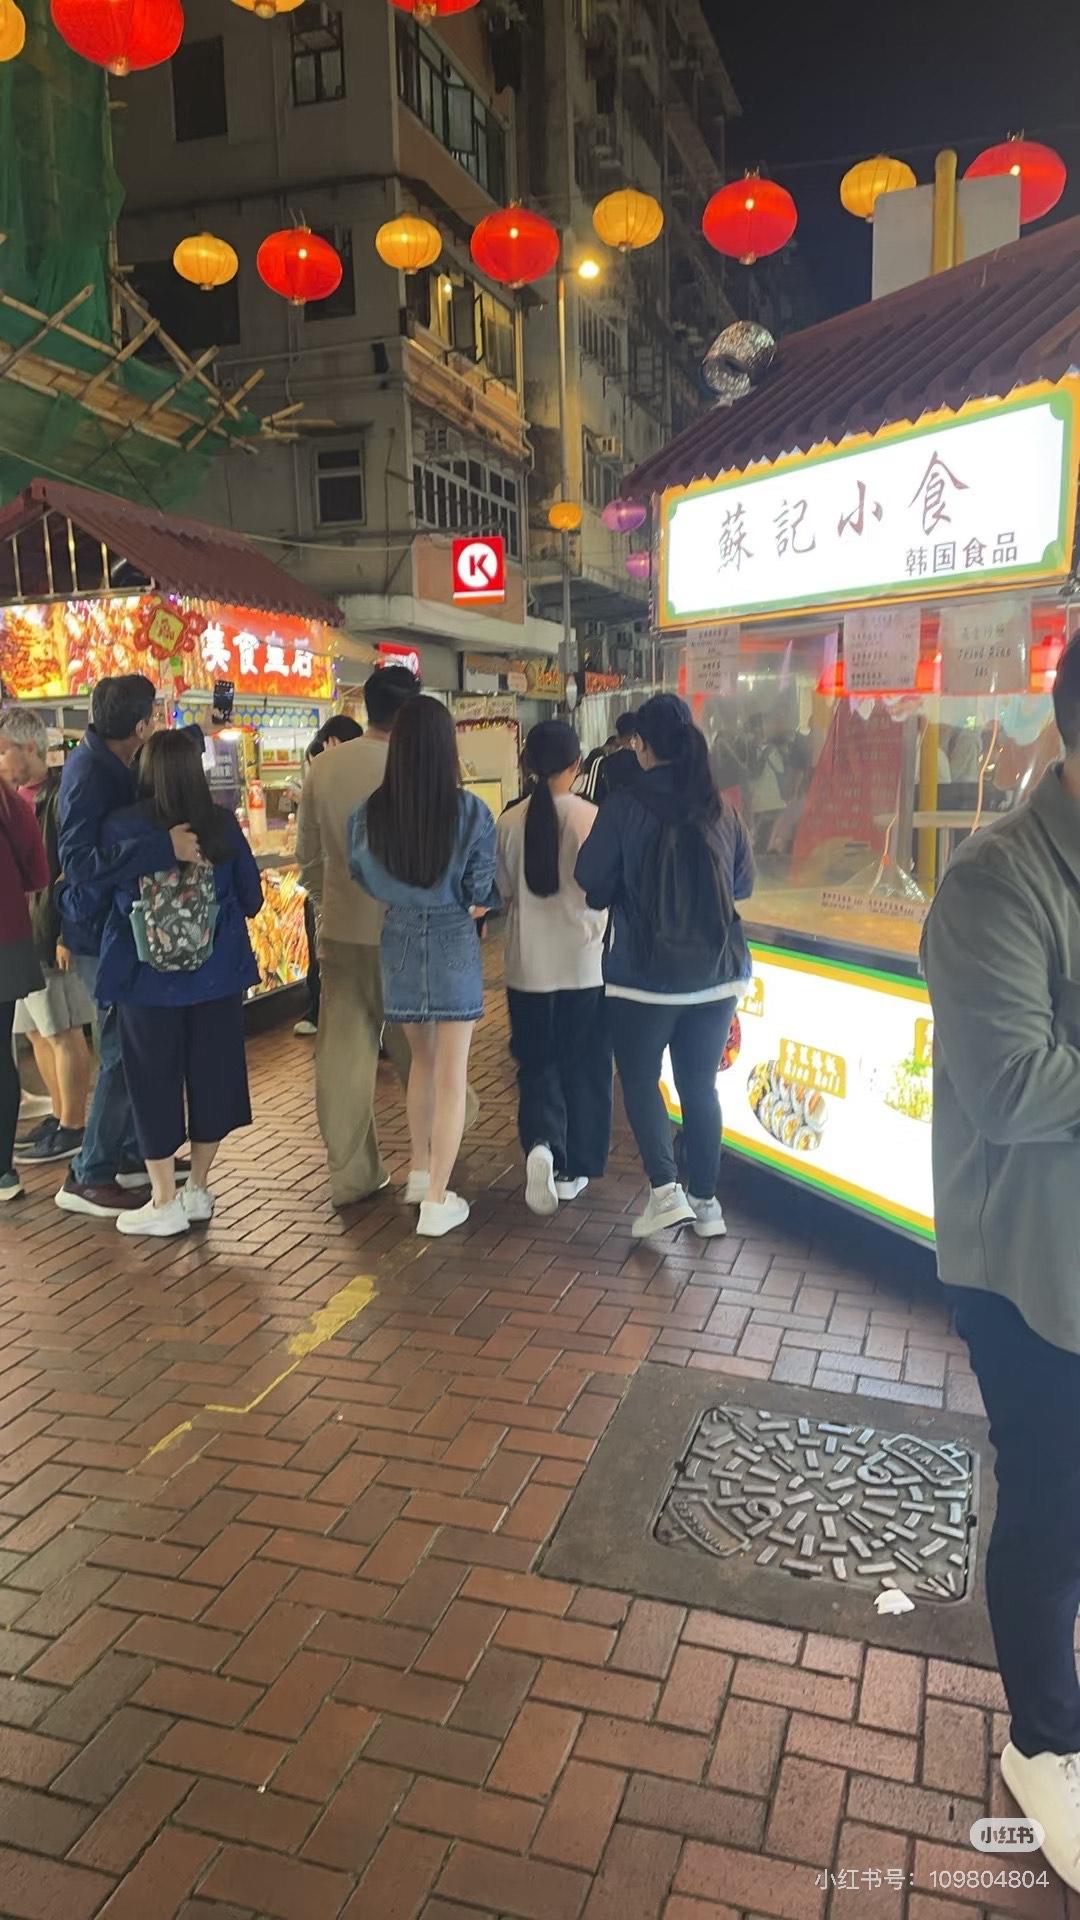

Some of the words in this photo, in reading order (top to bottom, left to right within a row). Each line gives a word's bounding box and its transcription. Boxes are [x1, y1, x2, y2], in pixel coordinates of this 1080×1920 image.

[716, 451, 970, 574] 蘇記小食
[905, 530, 1018, 576] 韩国食品
